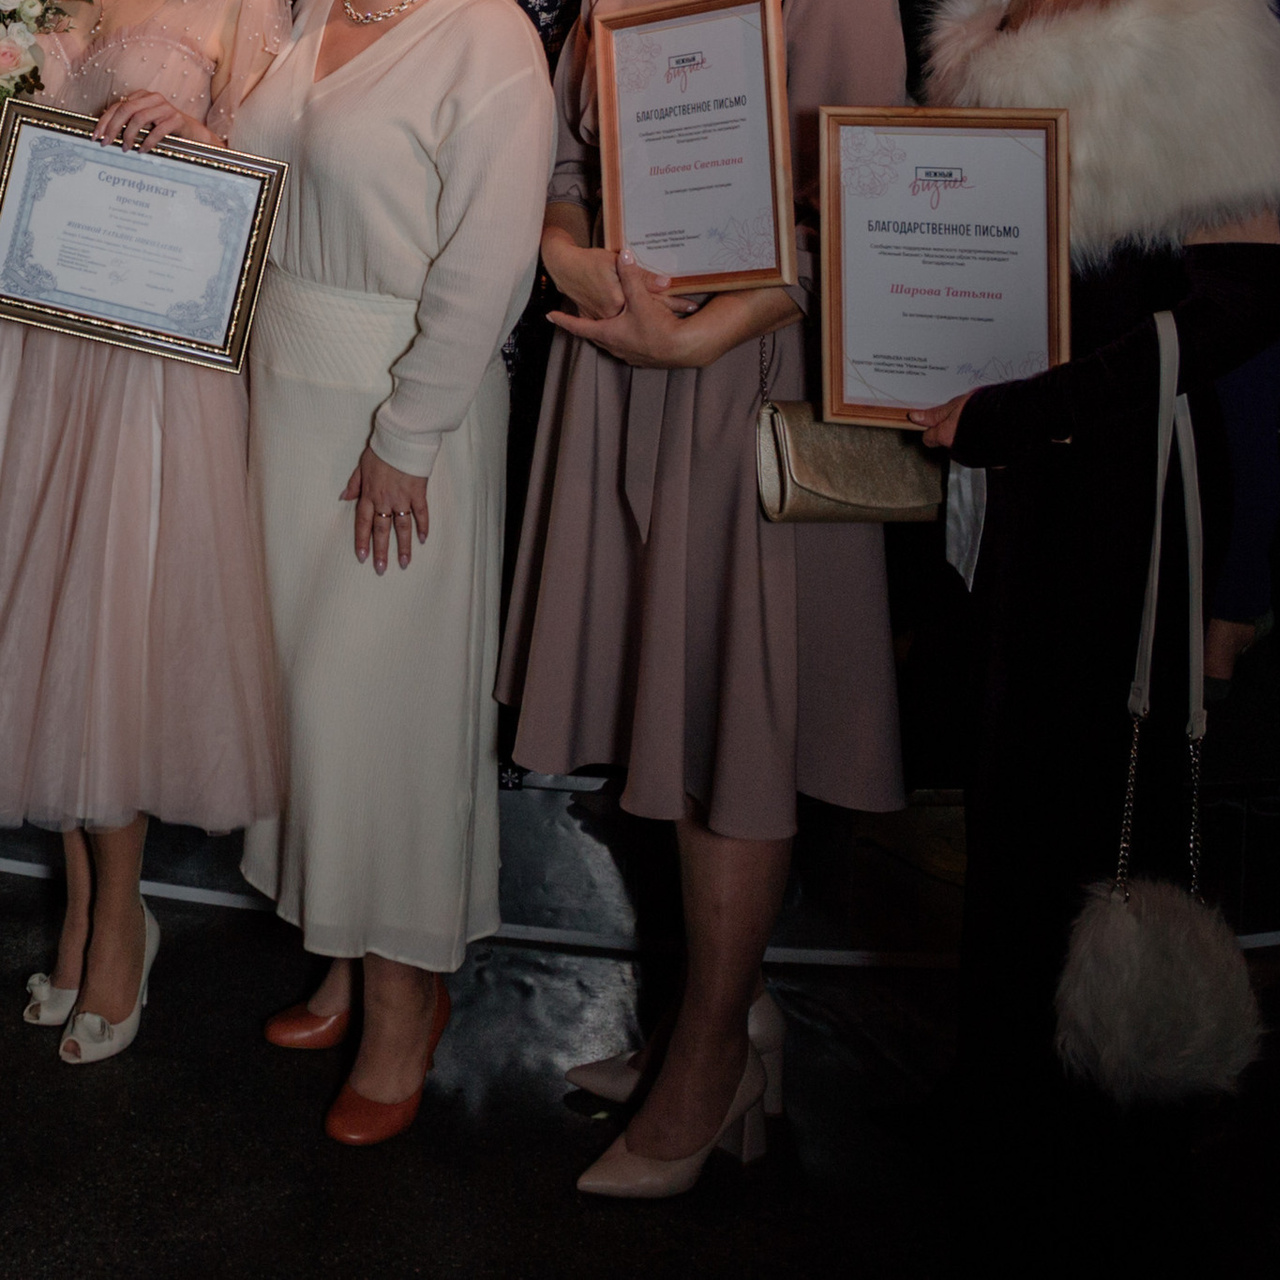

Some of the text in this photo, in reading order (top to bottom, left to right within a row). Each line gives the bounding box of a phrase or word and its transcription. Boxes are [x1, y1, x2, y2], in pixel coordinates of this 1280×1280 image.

[675, 56, 696, 66] НЕЖНЫЙ
[636, 95, 747, 123] БЛАГОДАРСТВЕННОЕ ПИСЬМО
[650, 156, 743, 176] Шибаева Светлана
[925, 170, 953, 178] НЕЖНЫЙ
[98, 170, 178, 198] Сертификат
[868, 219, 1020, 239] БЛАГОДАРСТВЕННОЕ ПИСЬМО
[890, 284, 1003, 300] Шарова Татьяна
